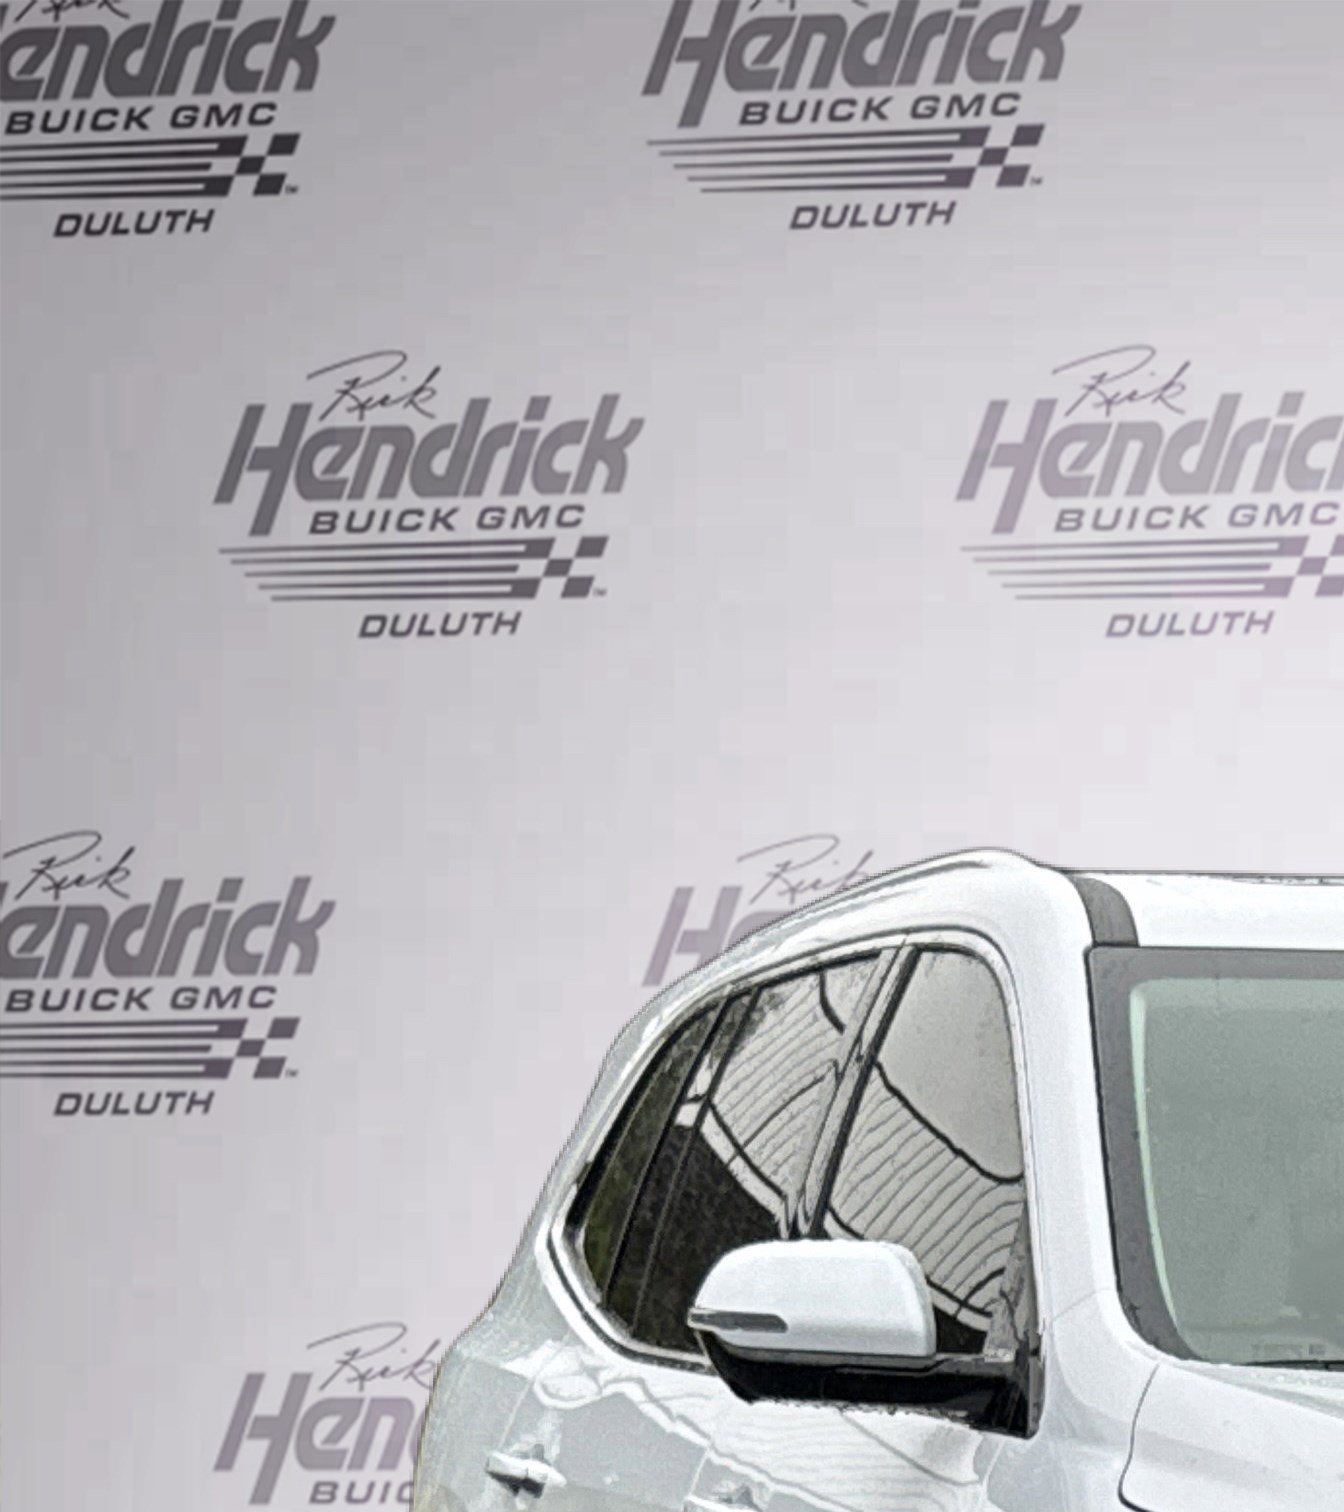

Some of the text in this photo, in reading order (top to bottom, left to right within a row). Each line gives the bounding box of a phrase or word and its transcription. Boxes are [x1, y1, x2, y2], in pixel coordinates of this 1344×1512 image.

[0, 0, 336, 103] endrick
[4, 101, 277, 136] BUICK GMC
[738, 92, 1022, 126] BUICK GMC
[53, 208, 215, 238] DULUTH
[789, 200, 957, 230] DULUTH
[213, 393, 645, 538] Hendrick
[308, 503, 585, 535] BUICK GMC
[1054, 501, 1341, 533] BUICK GMC
[358, 610, 522, 639] DULUTH
[1105, 610, 1275, 638] DULUTH
[0, 876, 336, 980] endrick
[4, 985, 277, 1013] BUICK GMC
[53, 1090, 215, 1117] DULUTH
[308, 1480, 414, 1506] BUIC
